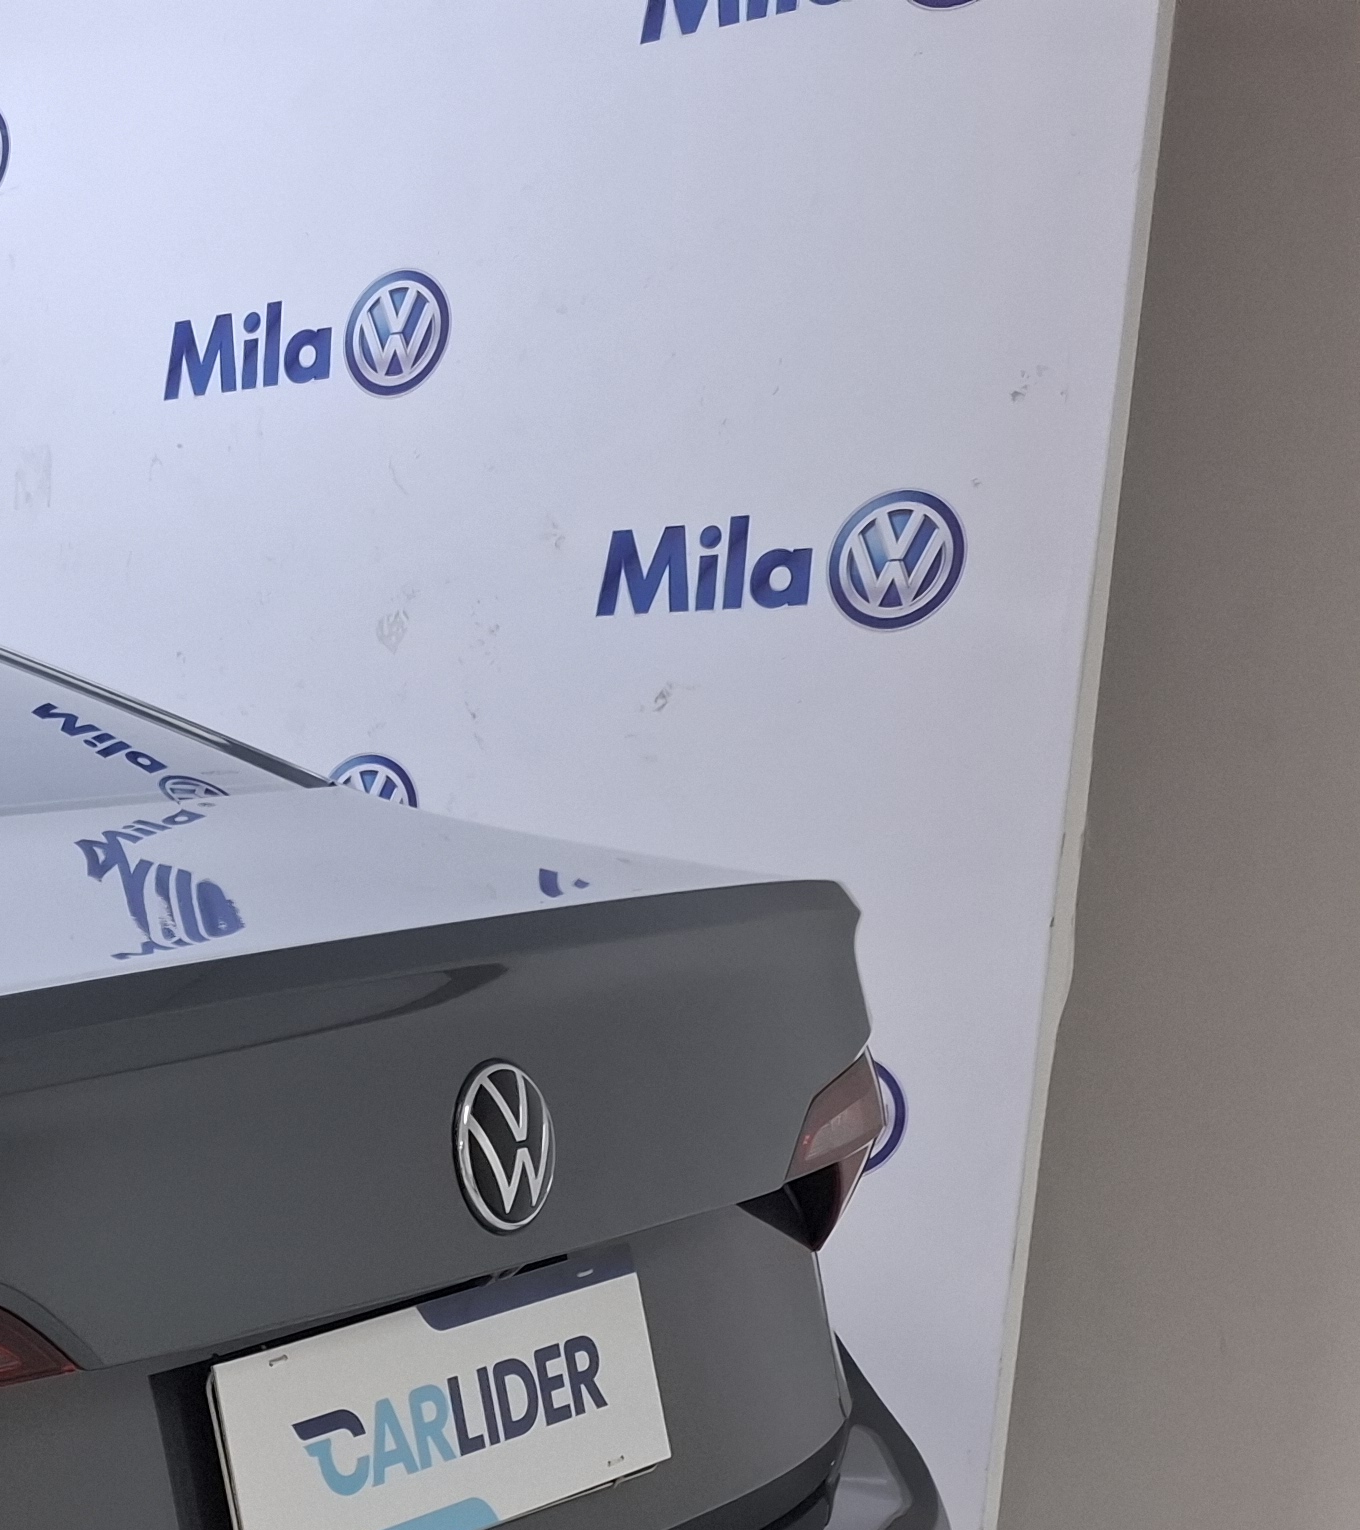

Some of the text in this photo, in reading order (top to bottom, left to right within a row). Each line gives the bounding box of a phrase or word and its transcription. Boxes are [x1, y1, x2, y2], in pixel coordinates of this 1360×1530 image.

[164, 301, 332, 400] Mila
[596, 515, 813, 616] Mila
[291, 1336, 608, 1496] CARLIDER
